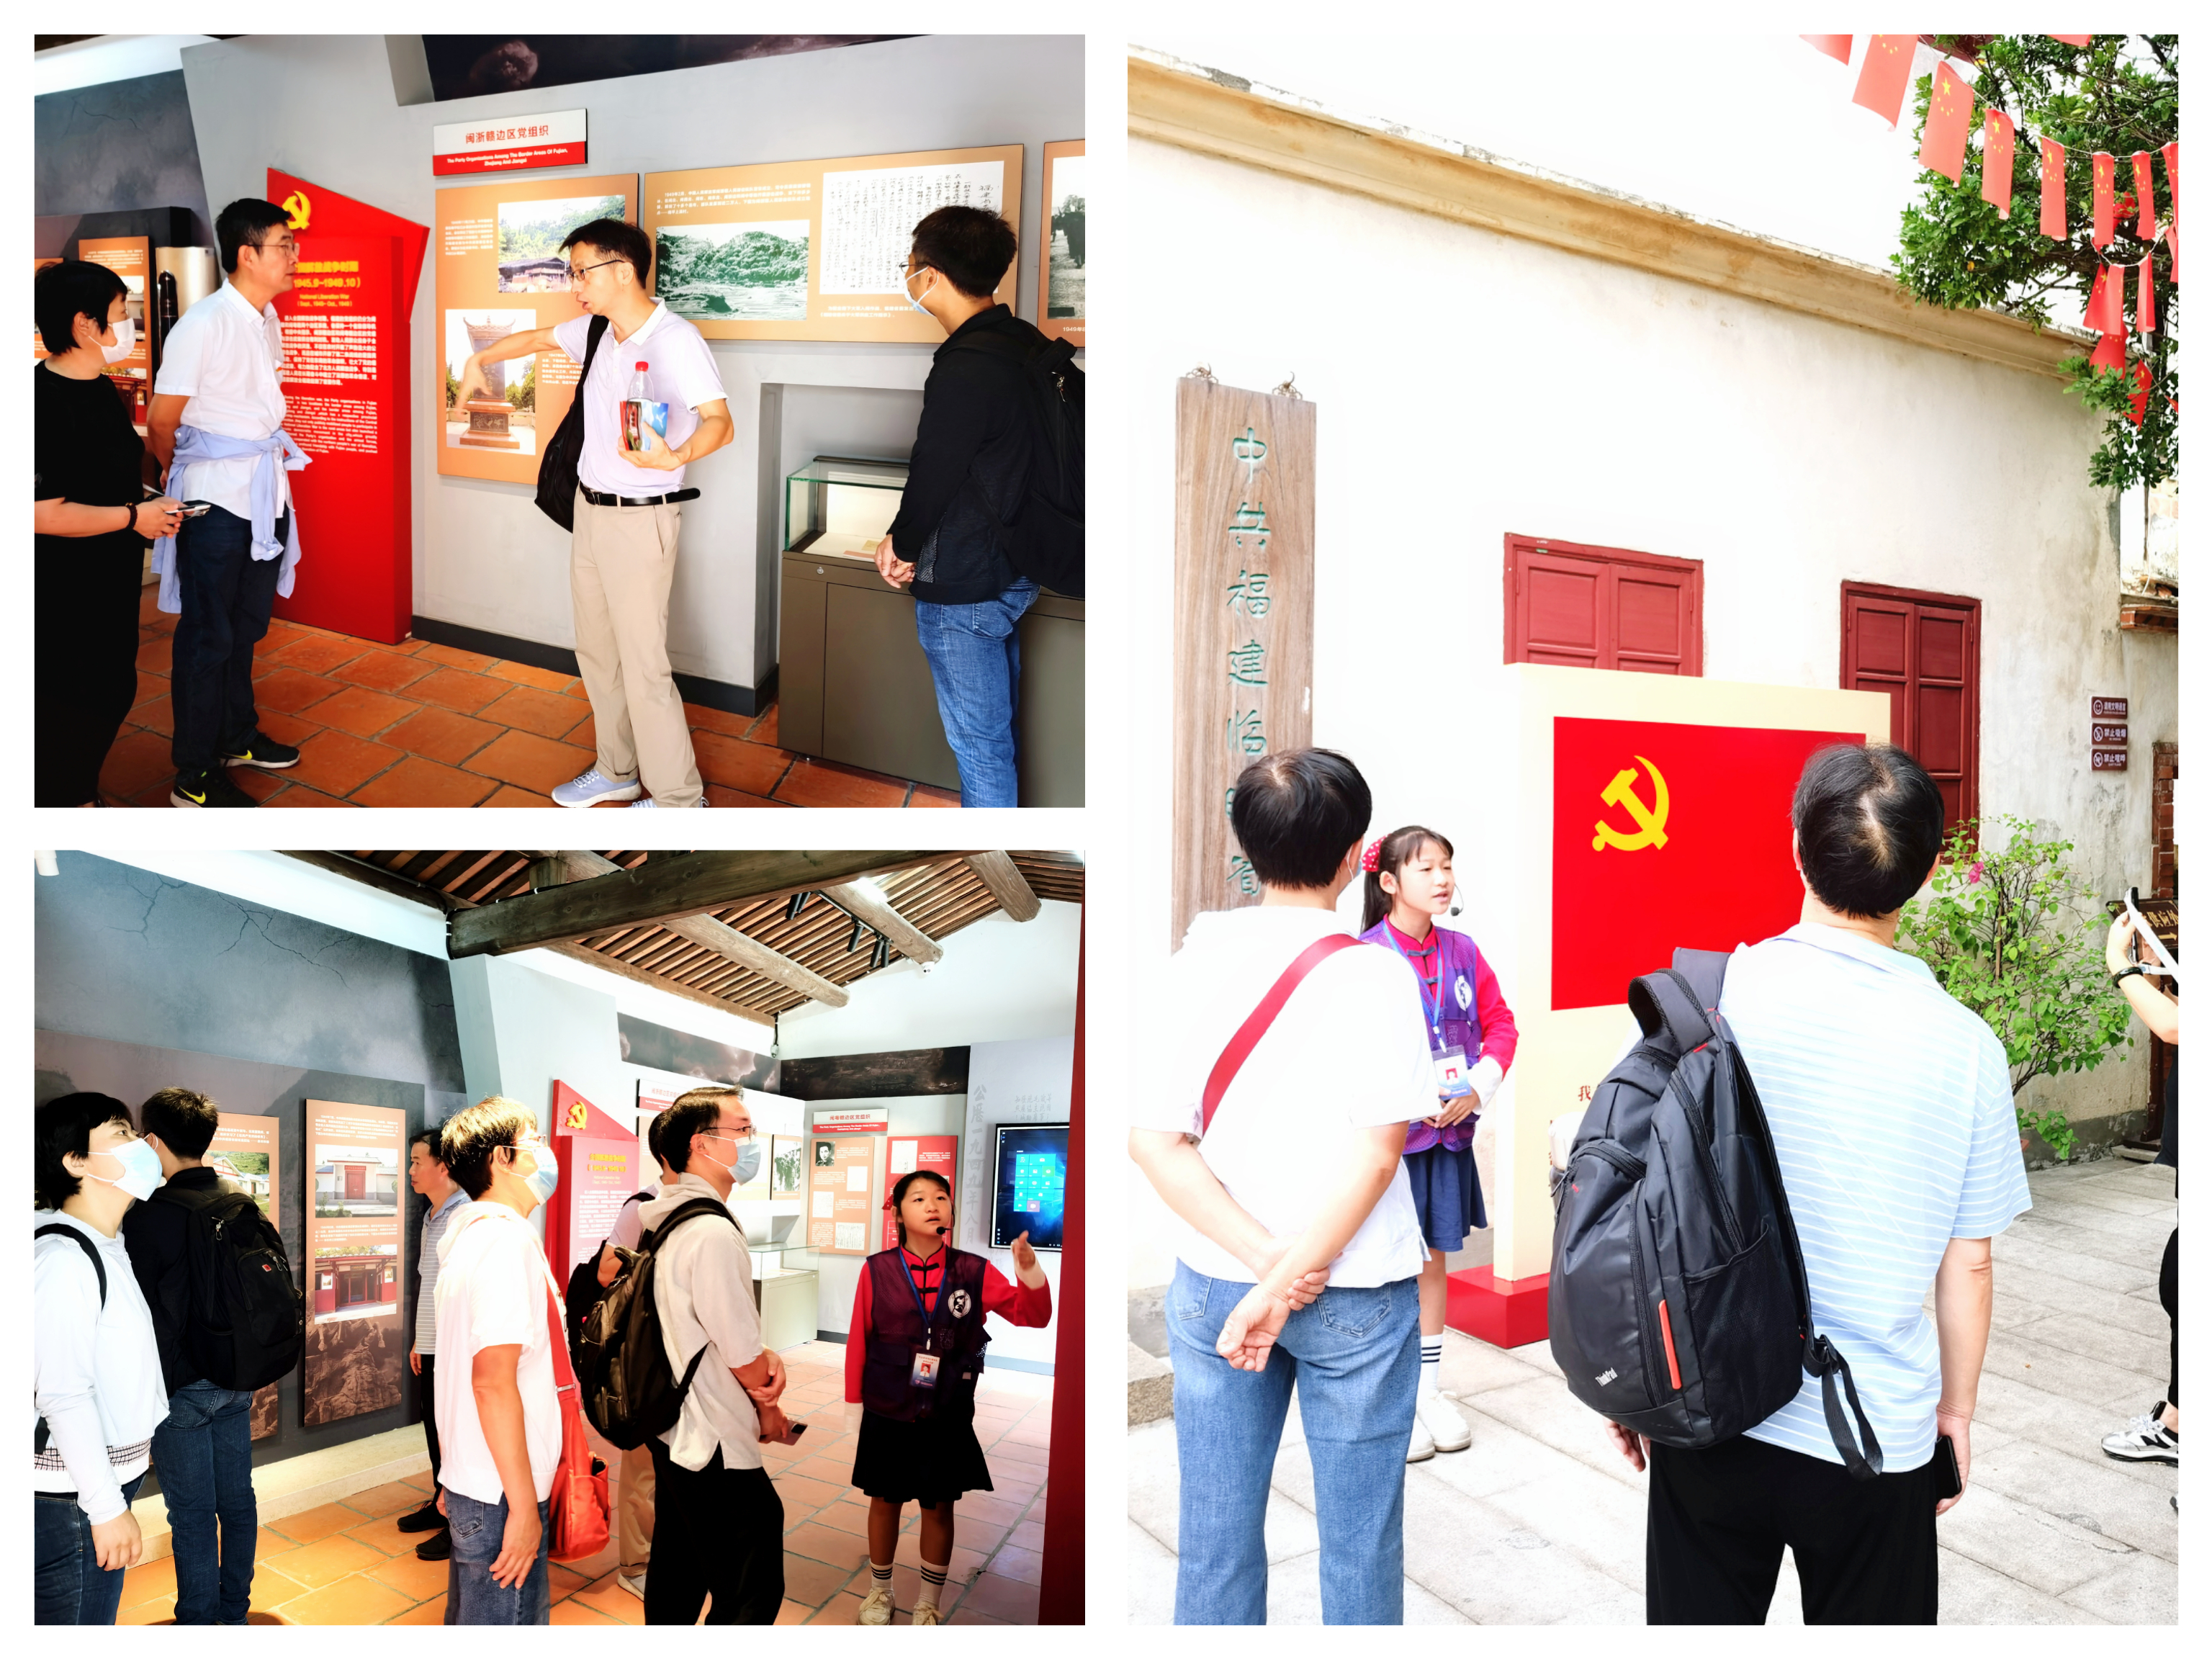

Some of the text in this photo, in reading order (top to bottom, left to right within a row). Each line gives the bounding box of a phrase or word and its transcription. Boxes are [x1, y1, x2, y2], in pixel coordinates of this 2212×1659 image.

[465, 125, 549, 144] 闽浙赣边区党组织
[1226, 427, 1272, 896] 中共福建临省
[2104, 728, 2126, 737] 禁止吸烟
